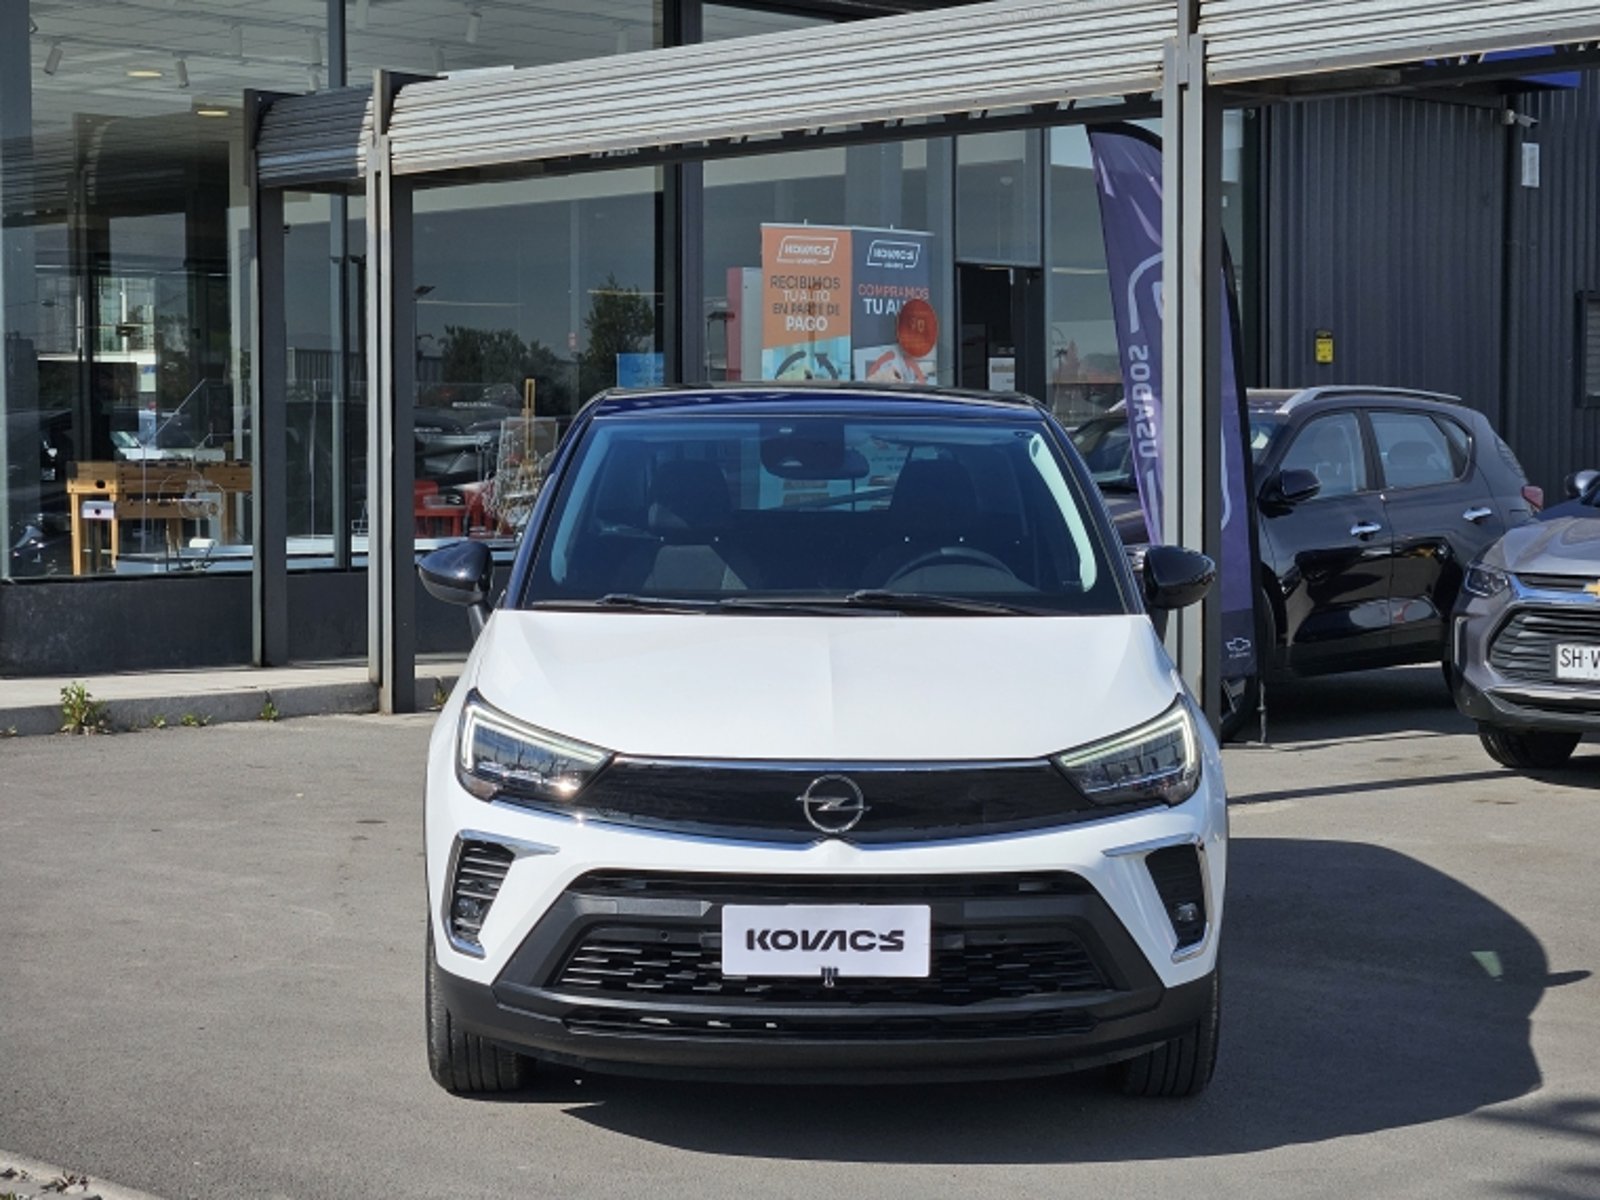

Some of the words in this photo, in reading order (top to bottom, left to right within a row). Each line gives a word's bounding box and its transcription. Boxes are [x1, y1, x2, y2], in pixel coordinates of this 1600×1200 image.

[770, 275, 841, 290] RECIBIMOS
[858, 283, 930, 300] COMPRAMOS
[773, 303, 788, 315] EN
[863, 298, 884, 315] TU
[785, 315, 828, 332] PAGO
[746, 928, 905, 952] KOVACS
